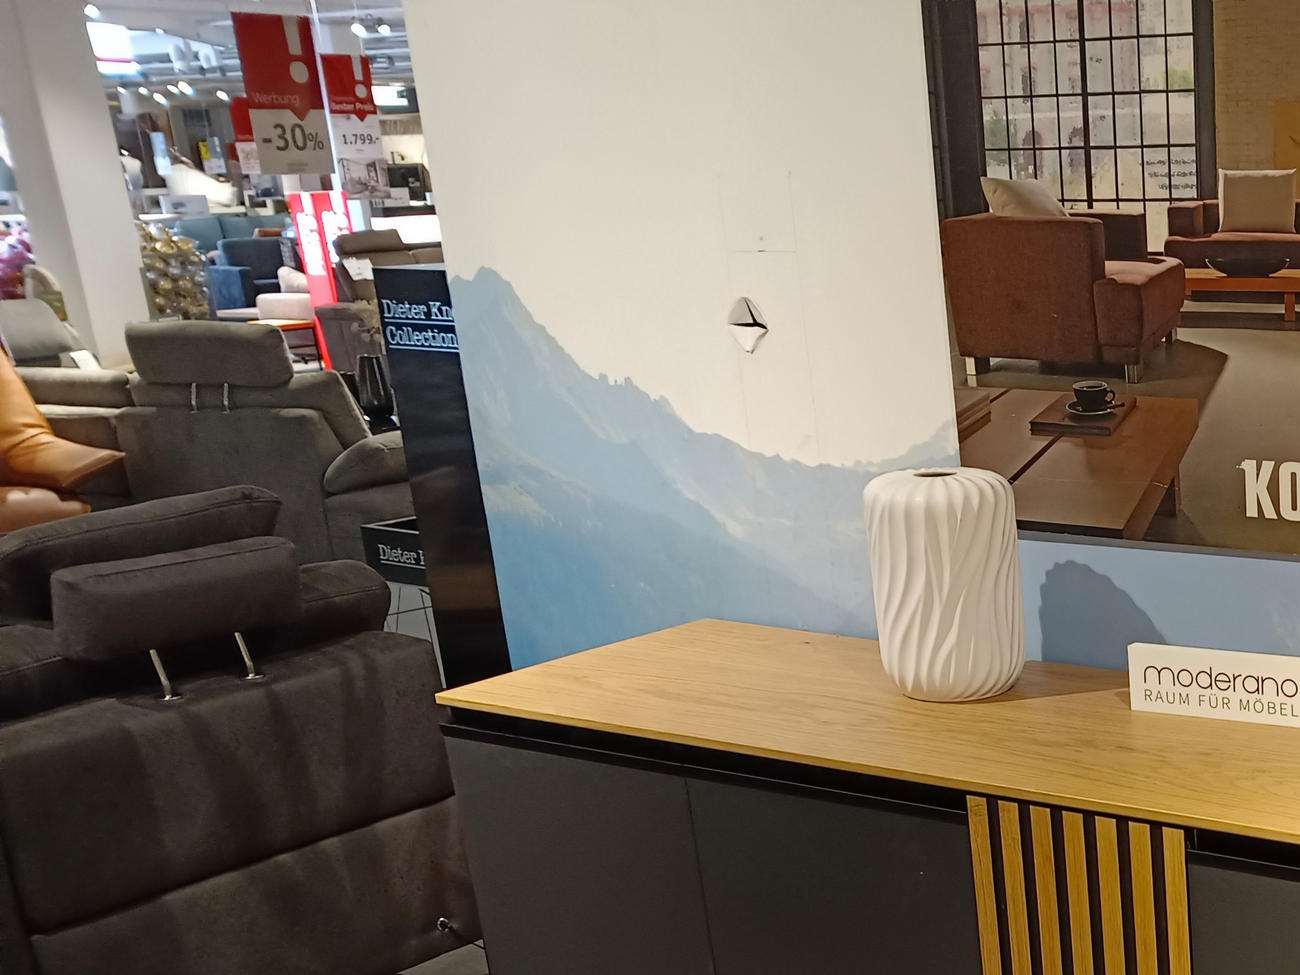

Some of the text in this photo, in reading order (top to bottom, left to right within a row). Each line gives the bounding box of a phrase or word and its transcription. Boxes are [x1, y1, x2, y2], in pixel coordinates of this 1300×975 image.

[253, 92, 299, 106] Werbung
[355, 103, 374, 111] Preis
[262, 122, 325, 151] -30%
[381, 299, 428, 319] Dieter
[386, 325, 459, 347] Collection
[377, 543, 417, 564] Dieter
[1143, 665, 1299, 698] moderano
[1144, 688, 1300, 718] RAUM FÜR MÖBEL
